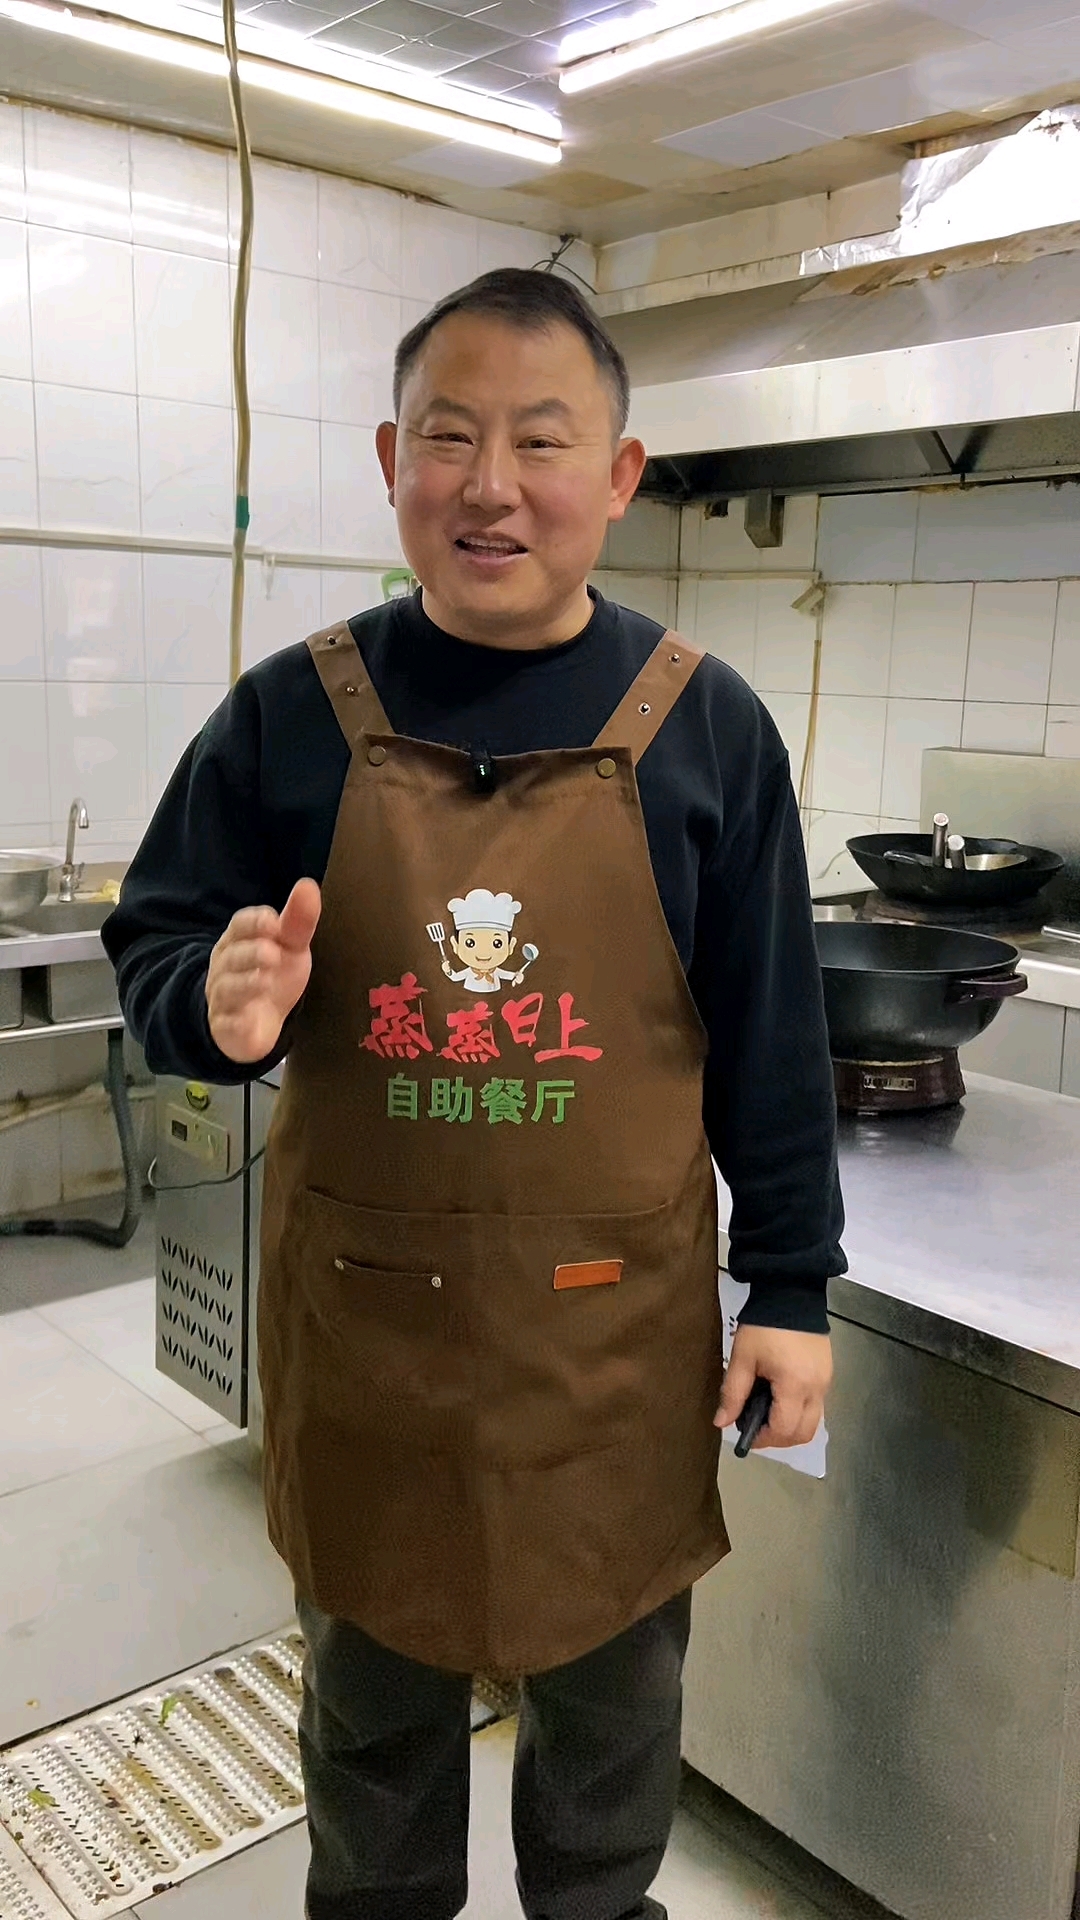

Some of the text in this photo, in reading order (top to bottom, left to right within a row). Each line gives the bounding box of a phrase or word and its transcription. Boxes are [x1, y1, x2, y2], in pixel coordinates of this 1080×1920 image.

[359, 971, 603, 1063] 蒸蒸日上
[387, 1072, 575, 1124] 自助餐厅
